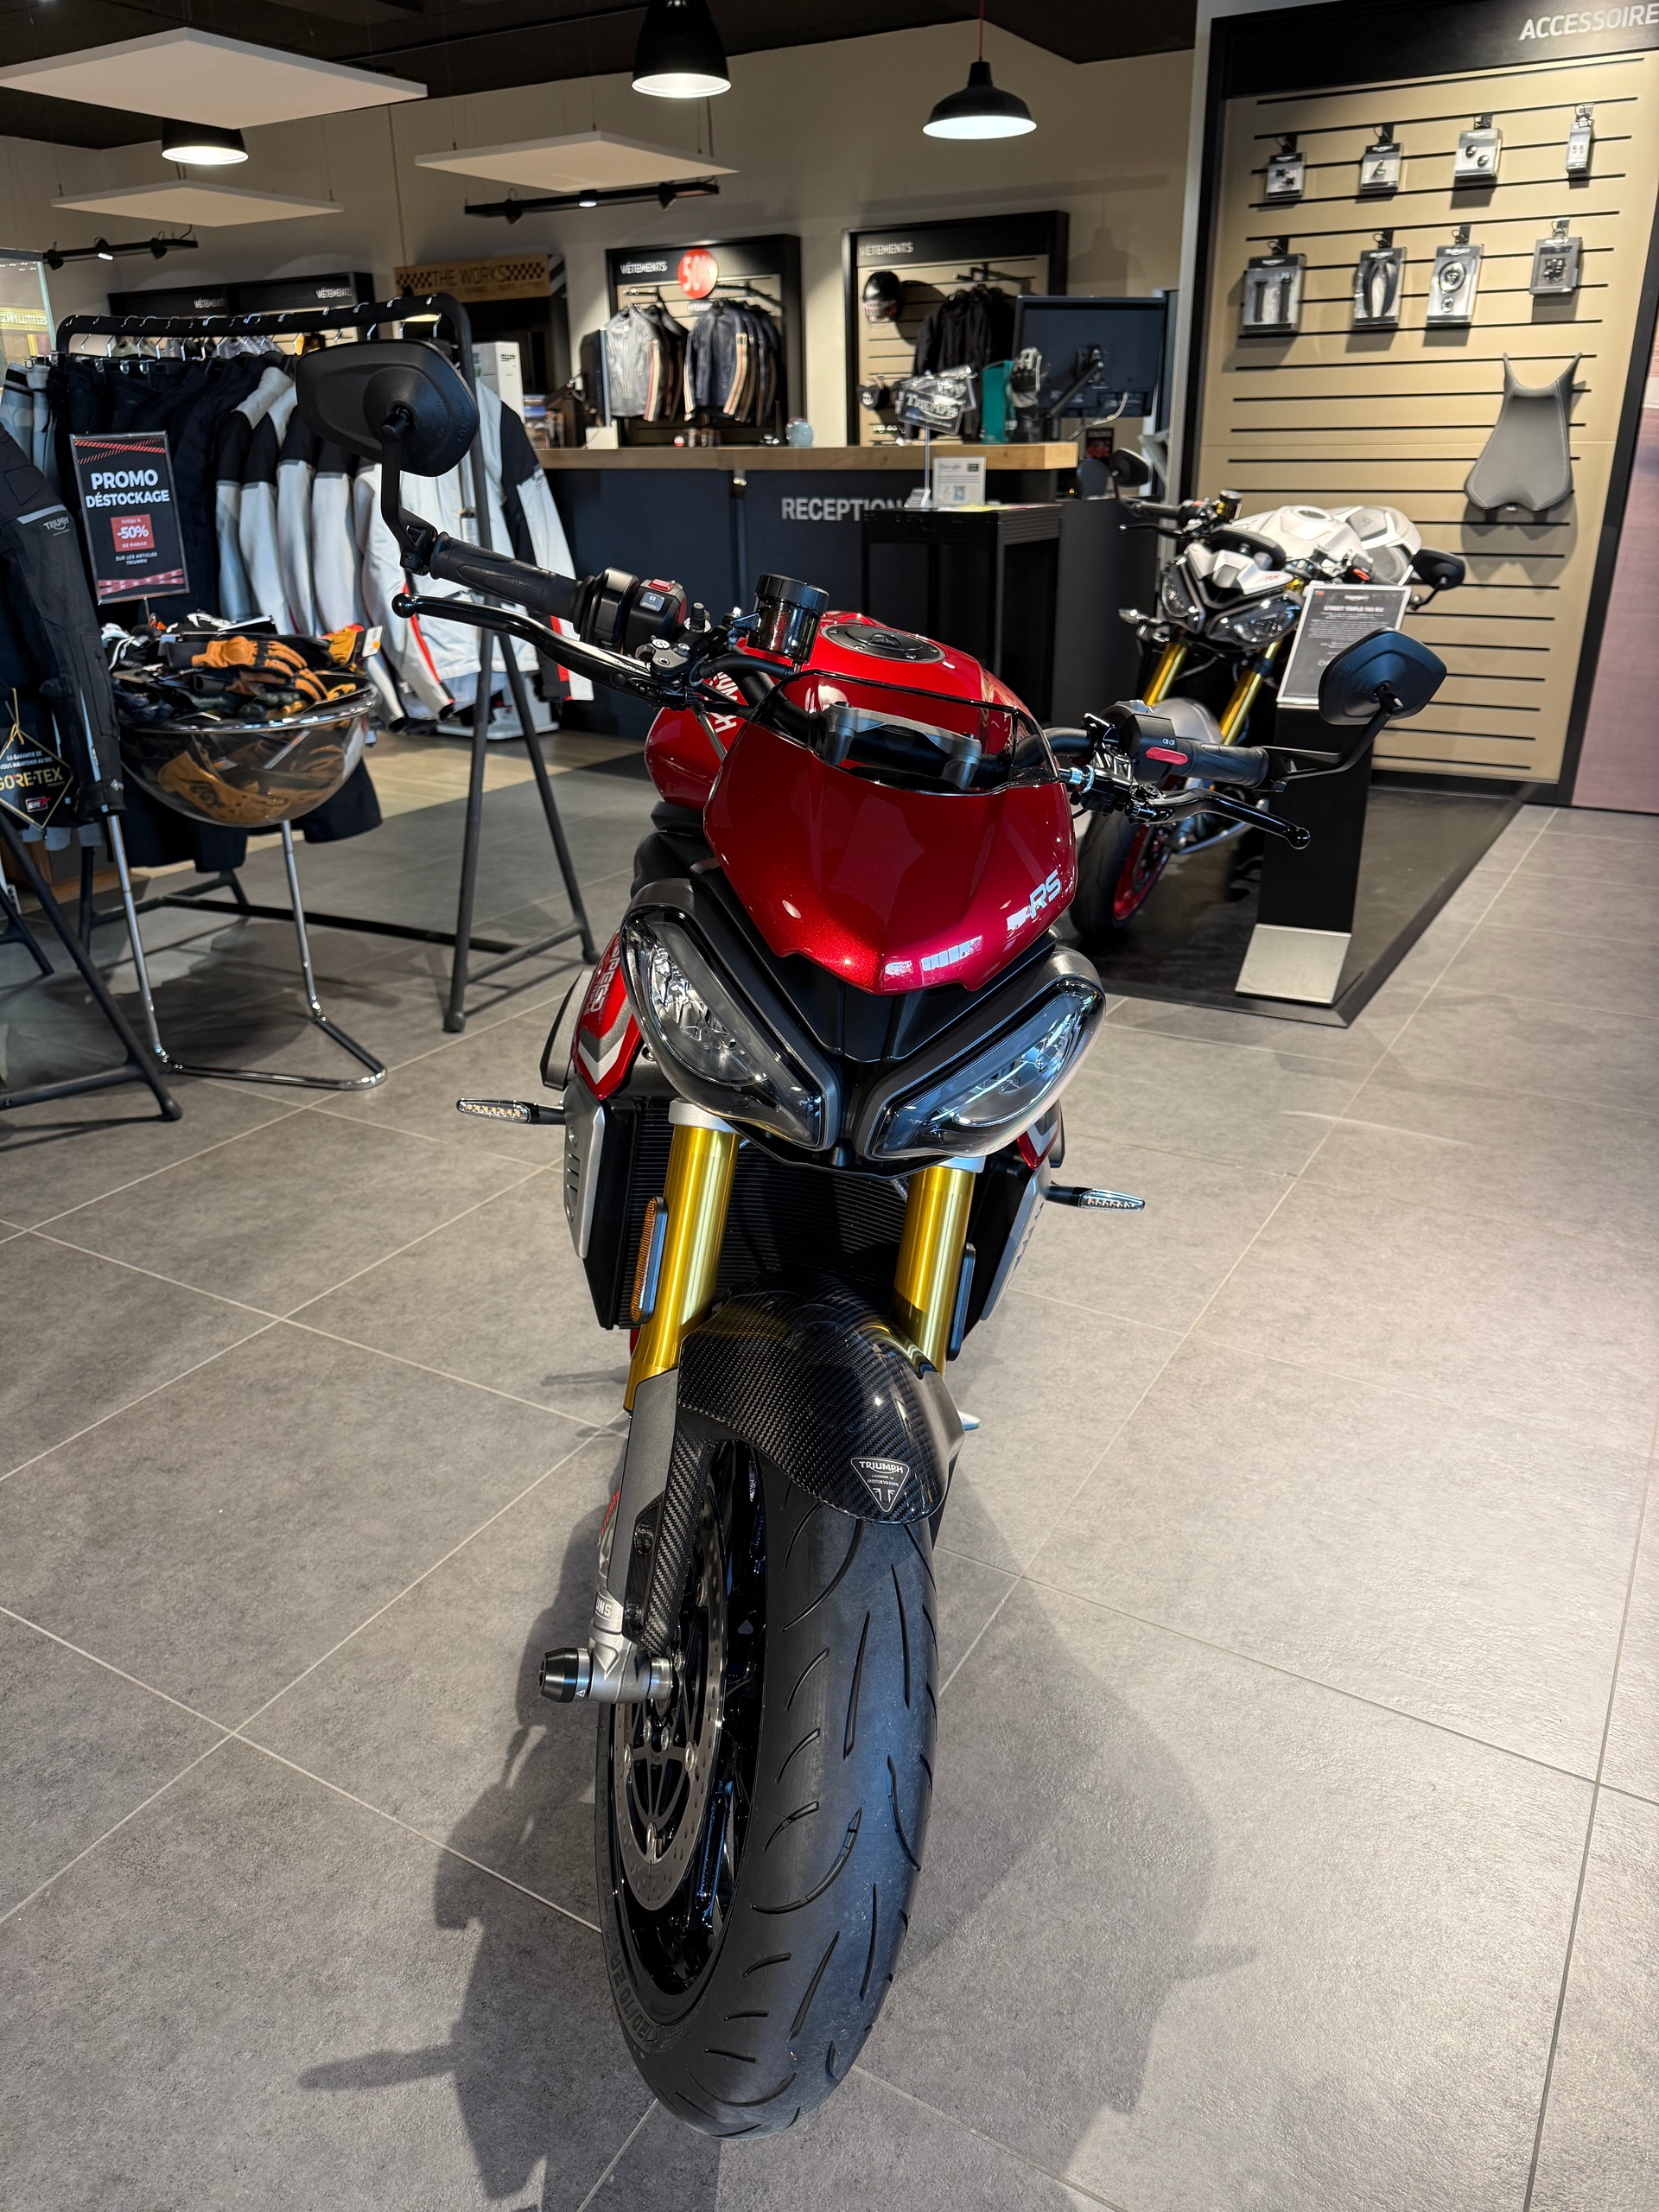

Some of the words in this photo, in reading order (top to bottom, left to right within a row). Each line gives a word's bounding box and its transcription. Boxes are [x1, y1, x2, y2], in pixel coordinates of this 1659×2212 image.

[1518, 3, 1659, 41] ACCESSOIRE
[91, 469, 158, 490] PROMO
[86, 490, 170, 508] DÉSTOCKAGE
[117, 524, 149, 540] -50%
[1029, 868, 1061, 918] RS
[859, 1461, 903, 1474] TRIUMPH
